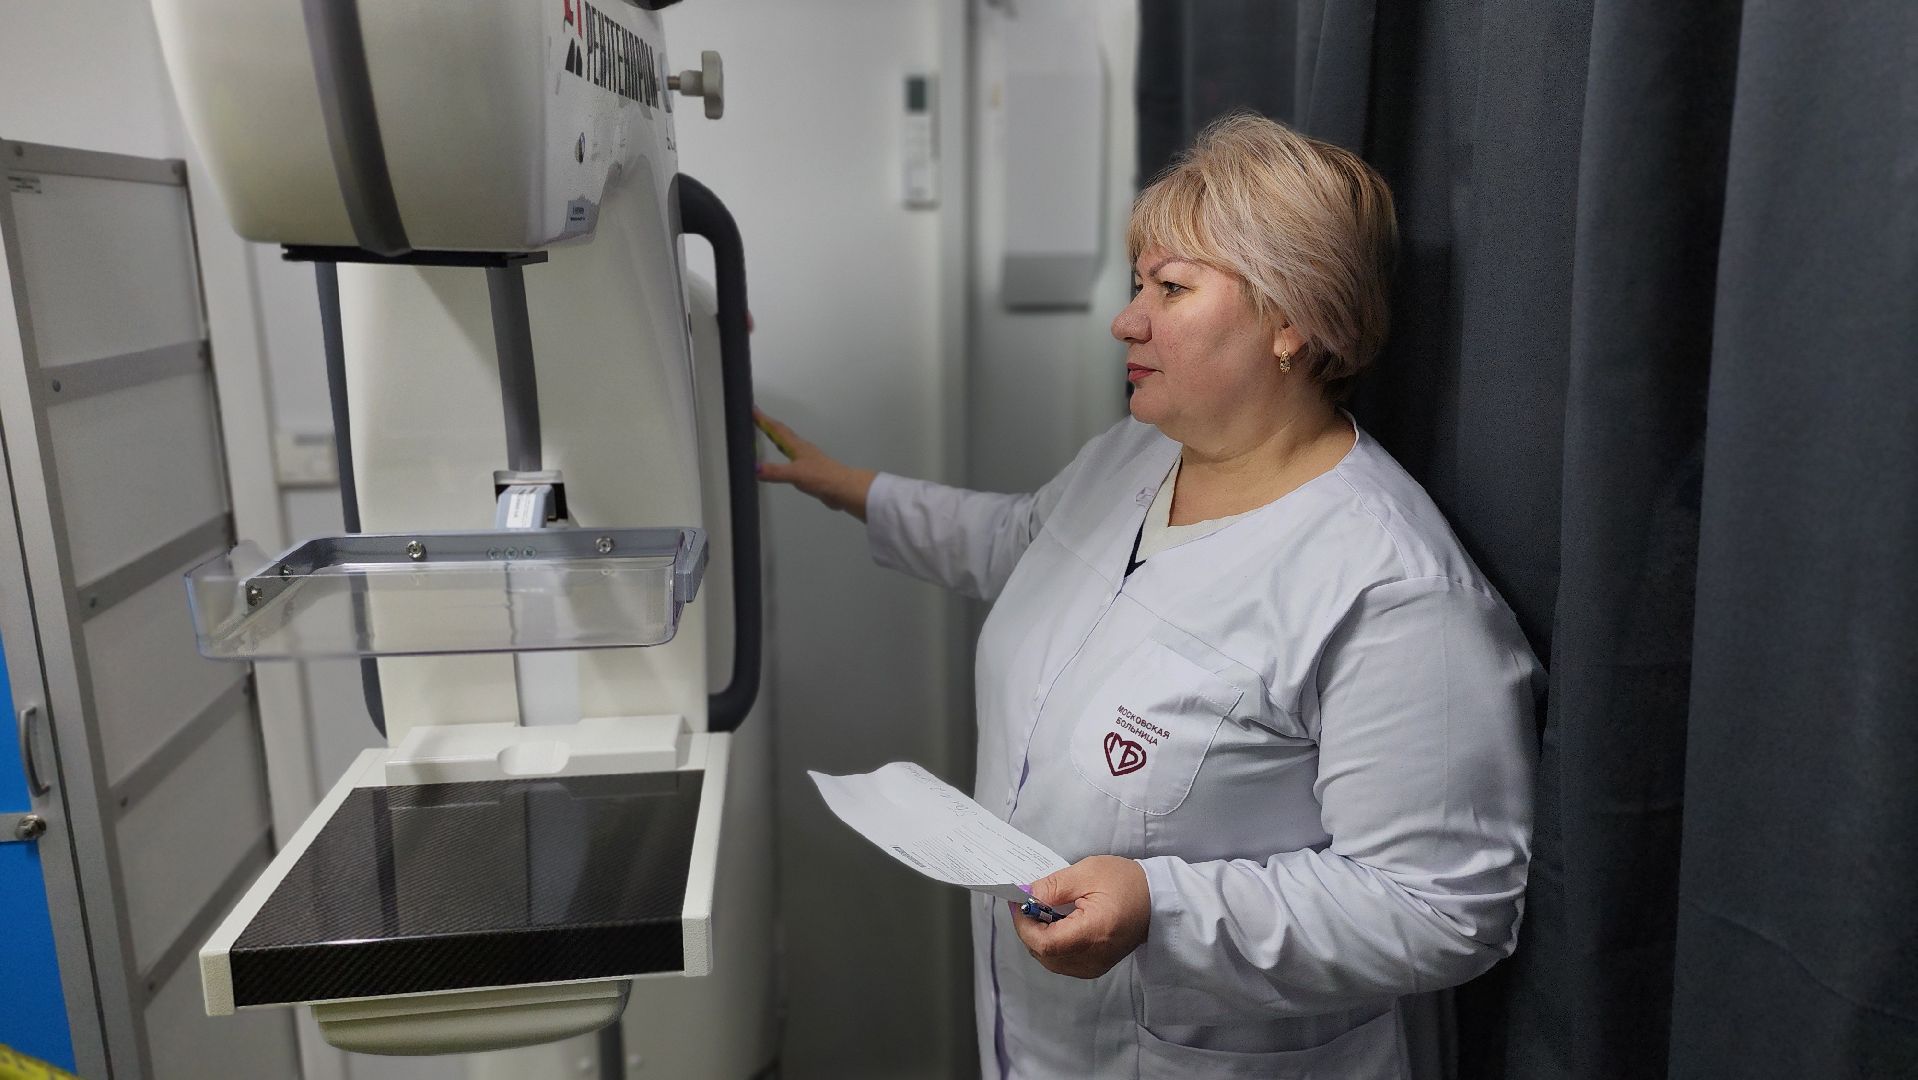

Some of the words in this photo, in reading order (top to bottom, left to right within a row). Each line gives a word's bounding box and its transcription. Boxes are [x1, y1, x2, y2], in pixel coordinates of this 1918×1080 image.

[585, 1, 659, 110] РЕНТГЕНПРОМ
[1115, 717, 1158, 746] БОЛЬНИЦА
[1117, 705, 1171, 740] МОСКОВСКАЯ
